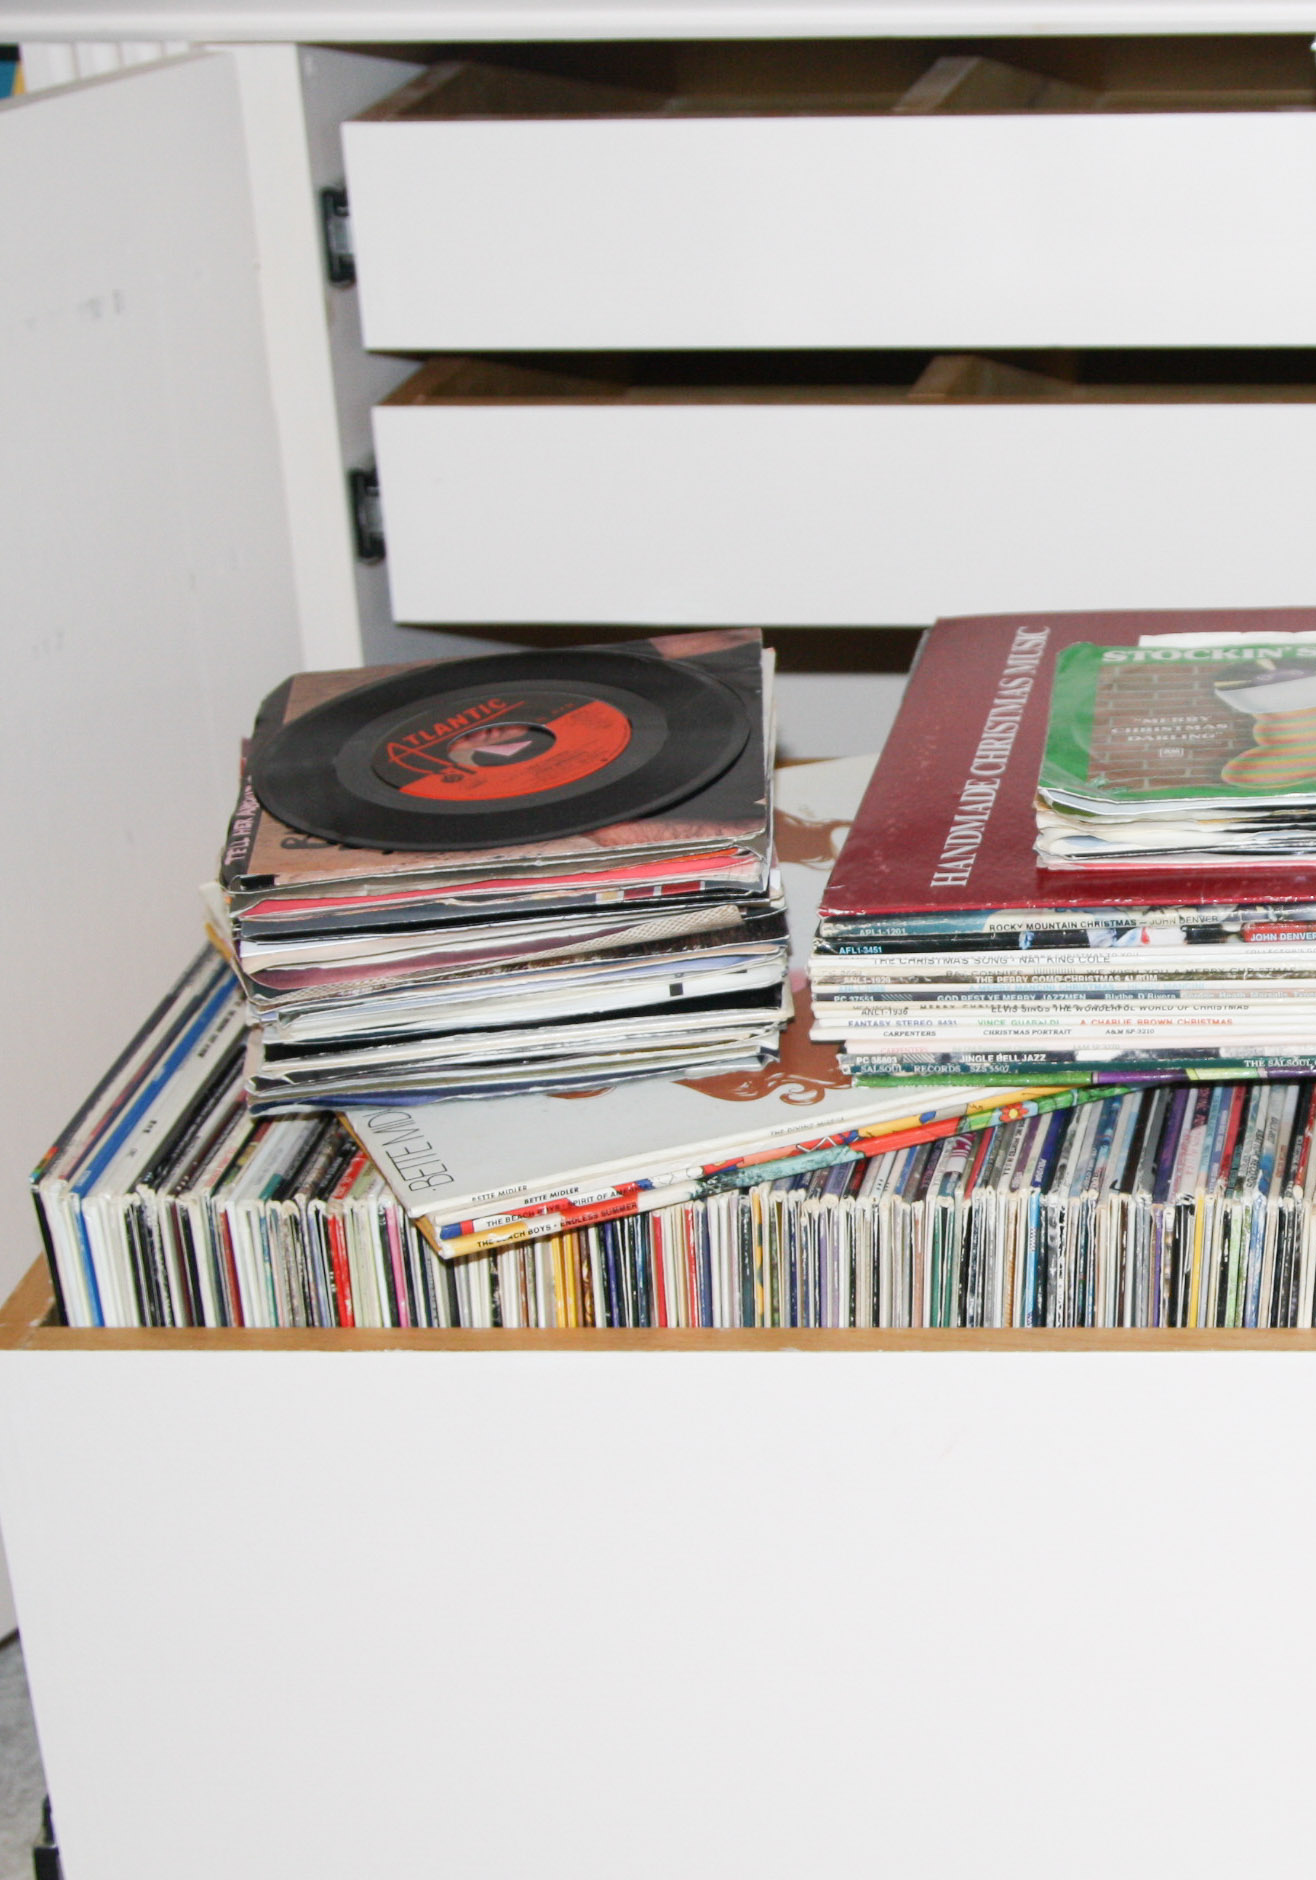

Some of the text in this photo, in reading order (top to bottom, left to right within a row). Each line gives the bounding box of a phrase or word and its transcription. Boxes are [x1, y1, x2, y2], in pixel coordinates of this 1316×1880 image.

[1102, 646, 1293, 663] STOCKIN'
[387, 698, 508, 765] ATLANTIC
[931, 626, 1050, 887] HANDMADE CHRISTMAS MUSIC
[224, 818, 254, 865] TELL HER
[989, 923, 1023, 932] ROCKY
[1026, 921, 1078, 931] MOUNTAIN
[1081, 919, 1136, 929] CHRISTMAS
[1179, 915, 1219, 924] DENVER
[1251, 932, 1278, 941] JOHN
[839, 946, 882, 954] AFL1-3451
[873, 958, 895, 966] THE
[900, 957, 968, 966] CHRISTMAS
[973, 957, 1008, 965] SONG
[1019, 956, 1042, 964] NAT
[1046, 955, 1075, 964] KING
[1078, 955, 1111, 963] COLE
[975, 976, 996, 984] THE
[1000, 976, 1030, 984] PERRY
[1064, 975, 1121, 983] CHRISTMAS
[856, 1056, 868, 1064] PC
[960, 1054, 995, 1063] JINGLE
[998, 1053, 1021, 1062] BELL
[1023, 1053, 1046, 1062] JAZZ
[1244, 1059, 1265, 1067] THE
[1267, 1058, 1312, 1067] SALSOUL
[861, 1064, 903, 1073] SALSOUL
[914, 1064, 961, 1073] RECORDS
[386, 1142, 454, 1192] BETTE
[472, 1186, 527, 1201] BETTE MIDLER
[524, 1187, 579, 1205] BETTE MIDLER
[487, 1218, 503, 1228] THE
[505, 1212, 535, 1224] BEACH
[597, 1193, 607, 1203] OF
[528, 1224, 551, 1235] BOYS
[560, 1214, 599, 1228] ENDLESS
[601, 1202, 637, 1217] SUMMER
